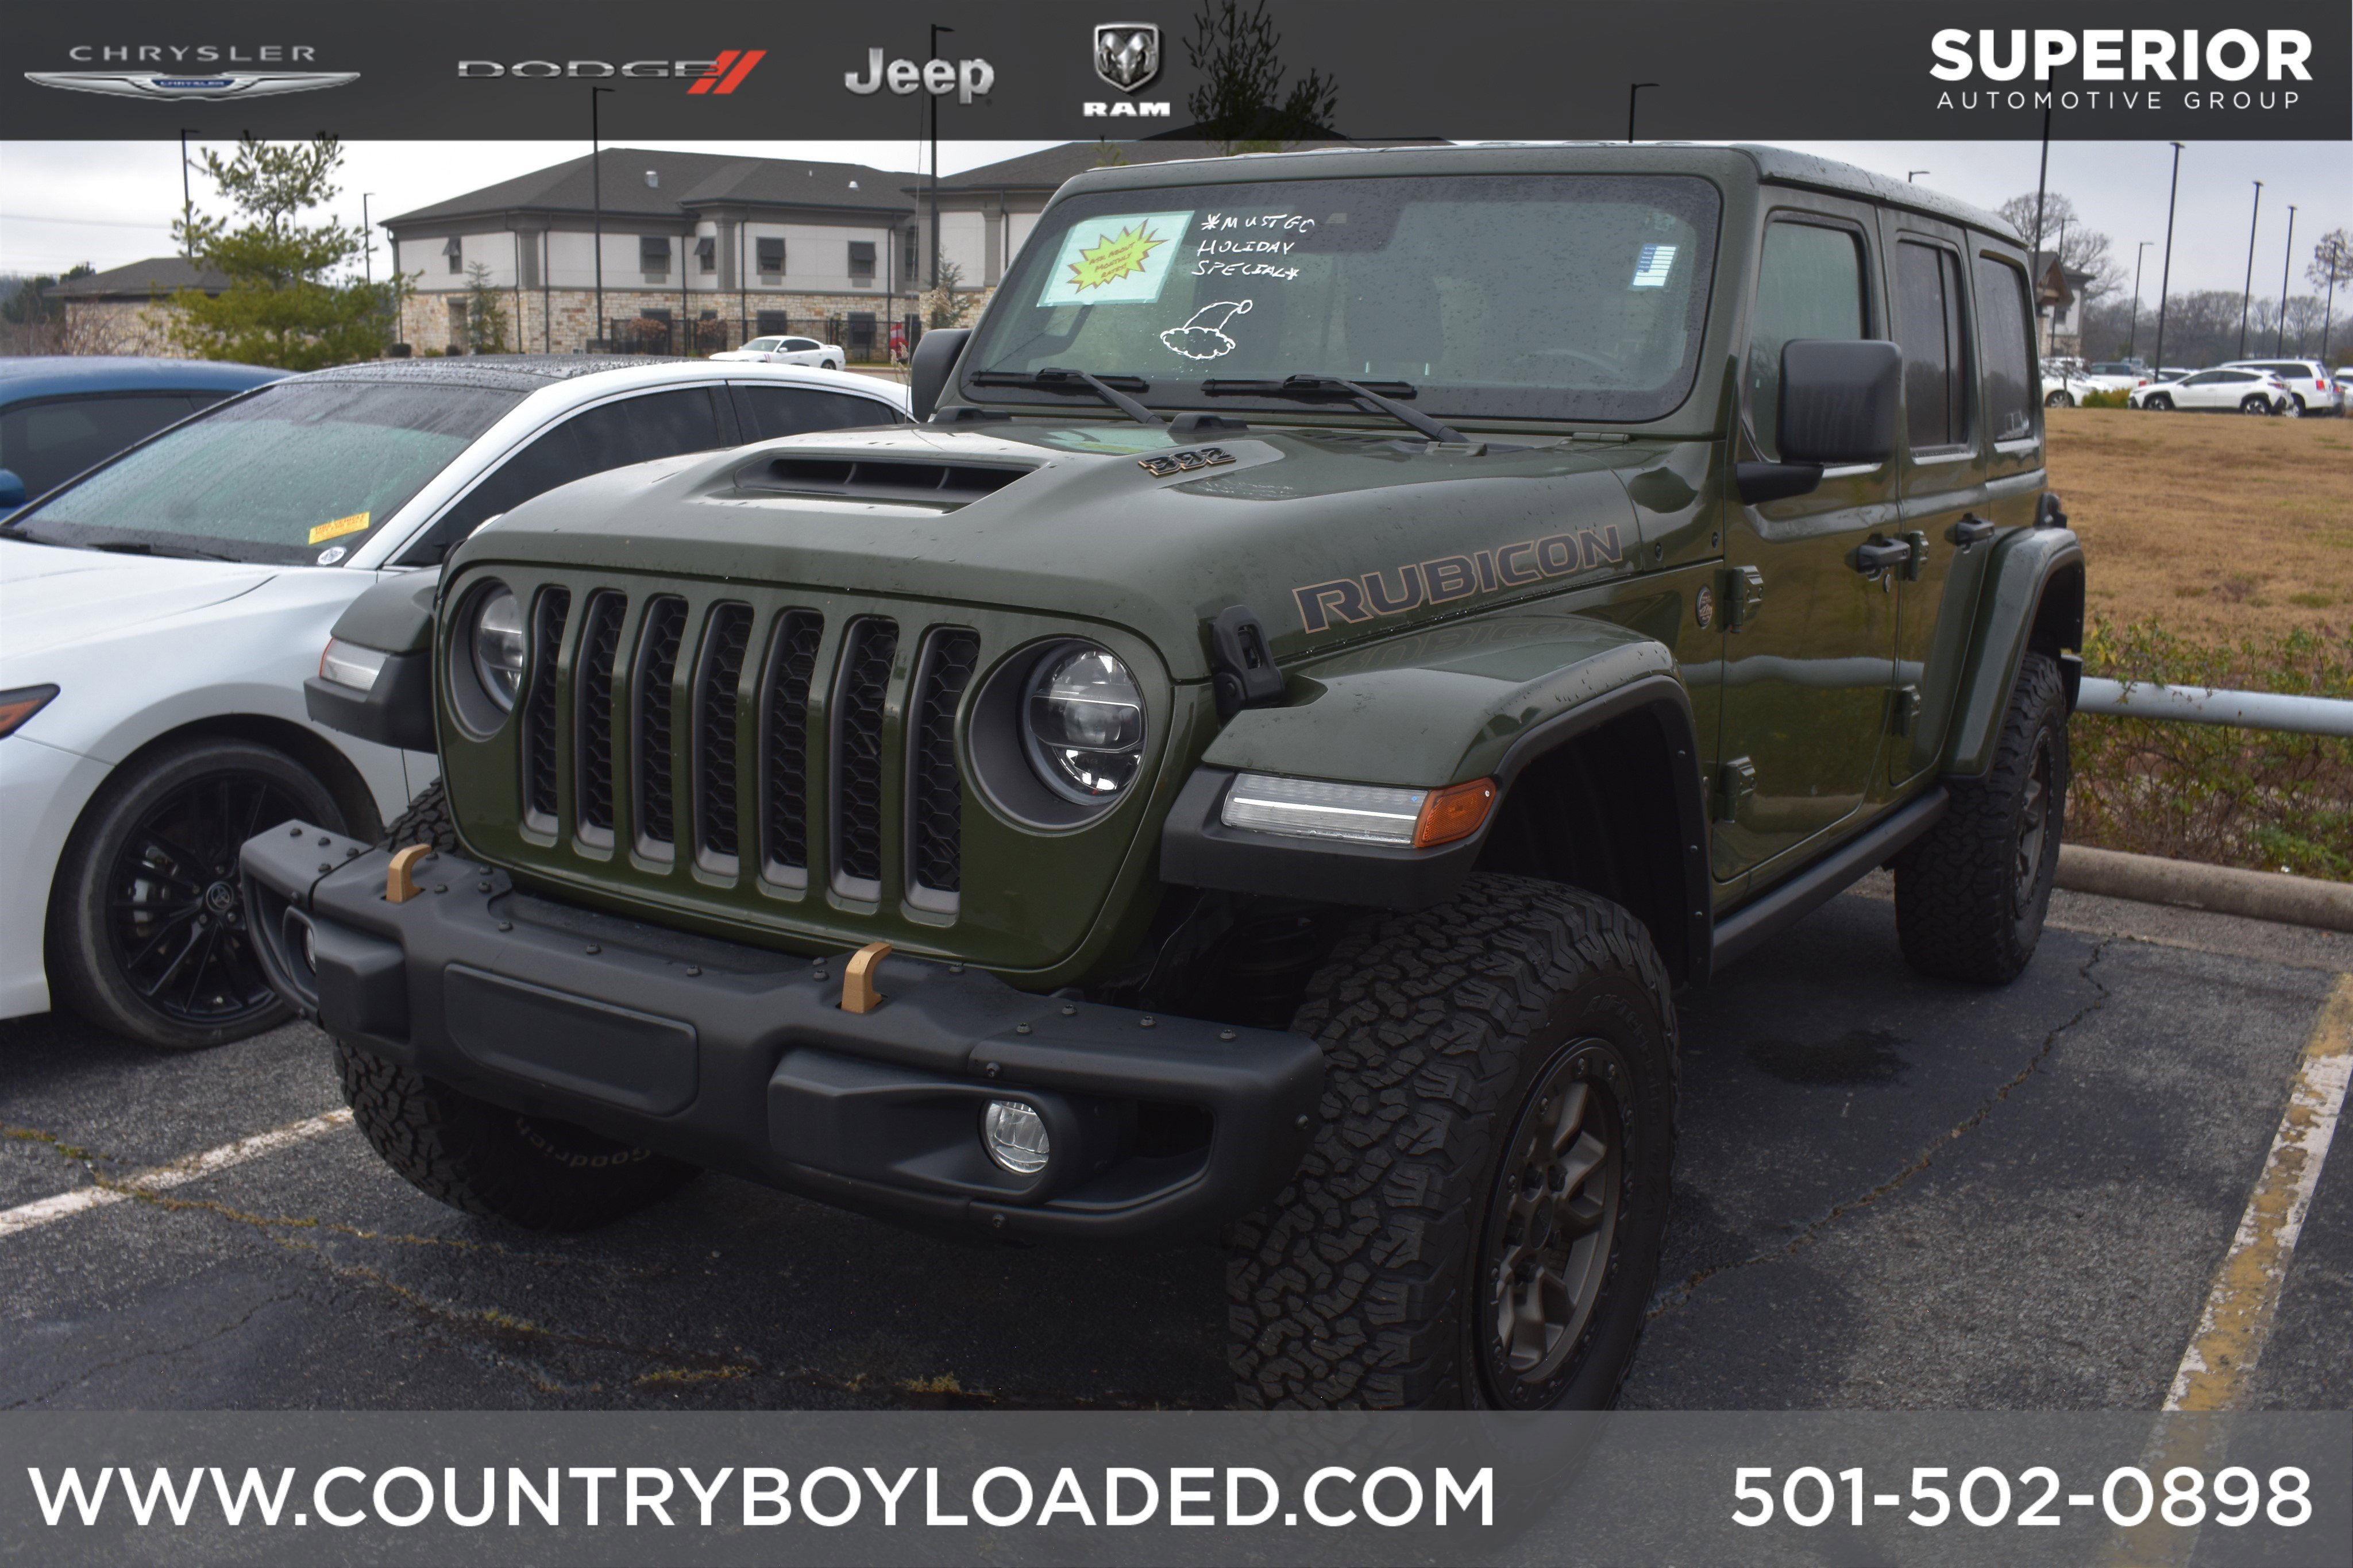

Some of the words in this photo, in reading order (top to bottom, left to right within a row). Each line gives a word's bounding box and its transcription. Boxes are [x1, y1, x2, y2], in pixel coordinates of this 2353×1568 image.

[1197, 240, 1295, 256] HOLIDAY
[1138, 447, 1237, 476] 392
[1292, 525, 1622, 634] RUBICON
